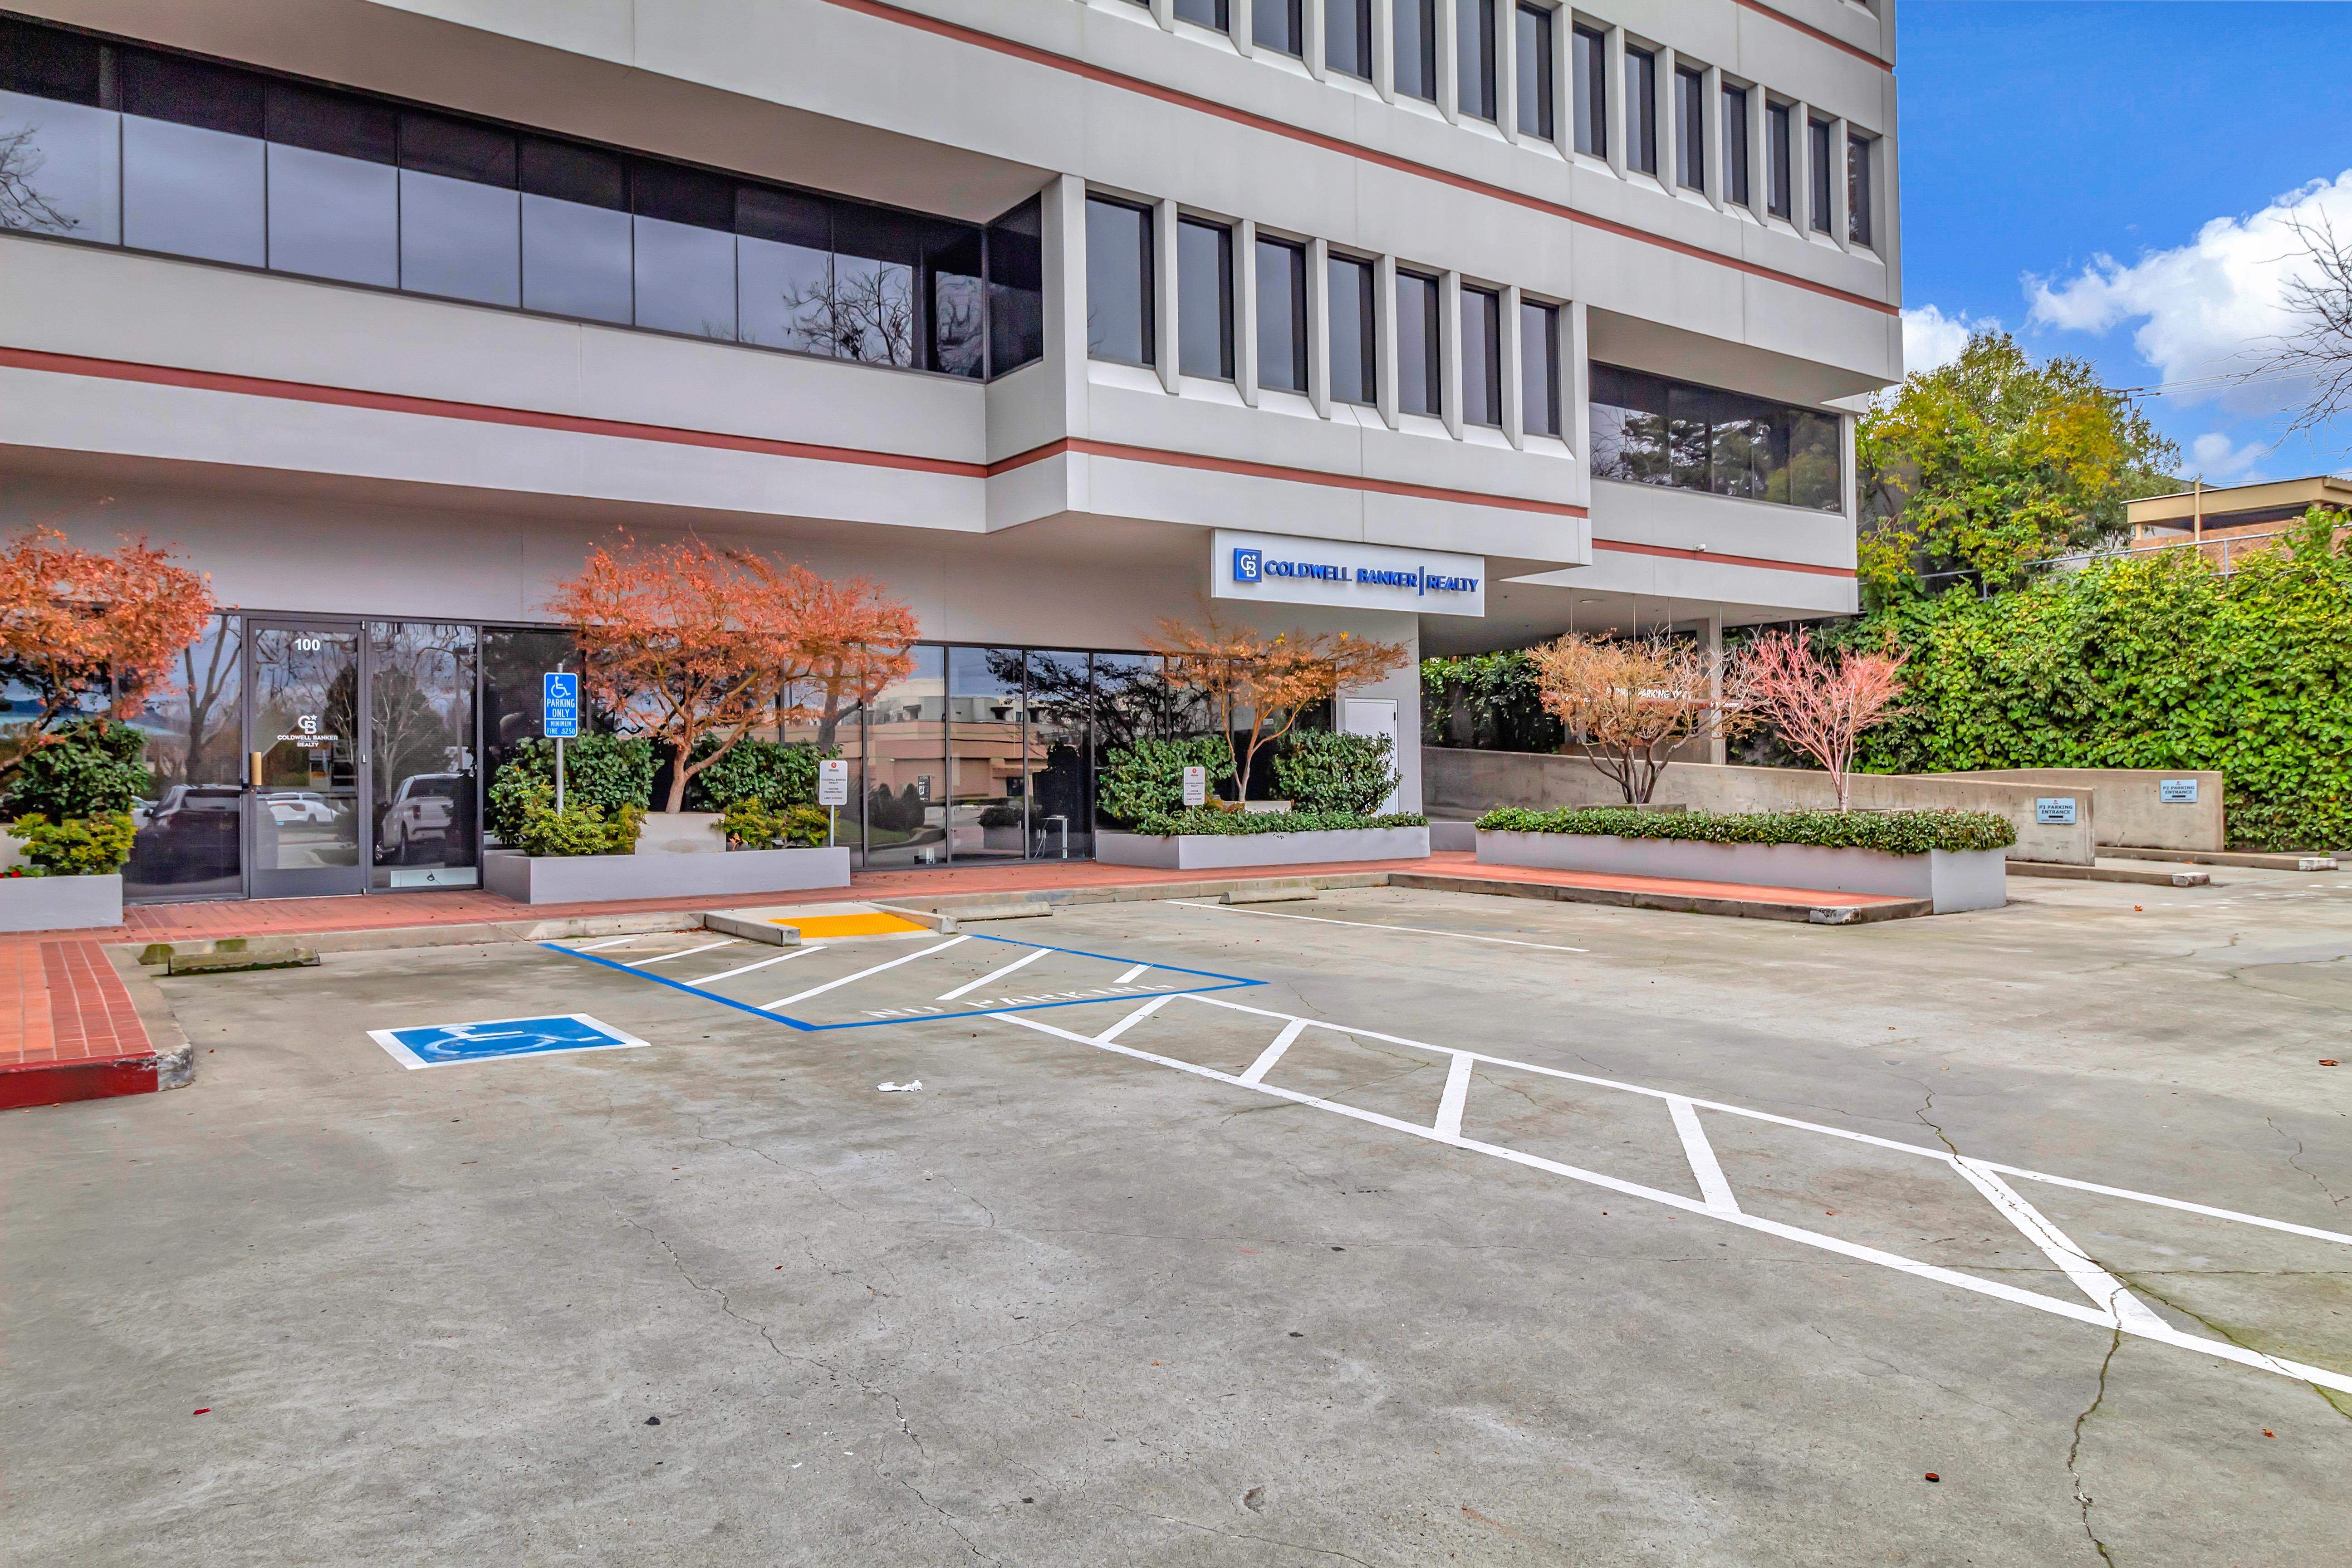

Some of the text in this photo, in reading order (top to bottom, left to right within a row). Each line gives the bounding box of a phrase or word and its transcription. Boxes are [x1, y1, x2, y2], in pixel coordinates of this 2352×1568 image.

[1264, 560, 1479, 592] COLDWELL BANKER REALTY
[295, 639, 320, 651] 100
[547, 699, 575, 708] PARKING
[552, 709, 569, 717] ONLY
[860, 985, 1176, 1018] NO PARKING
